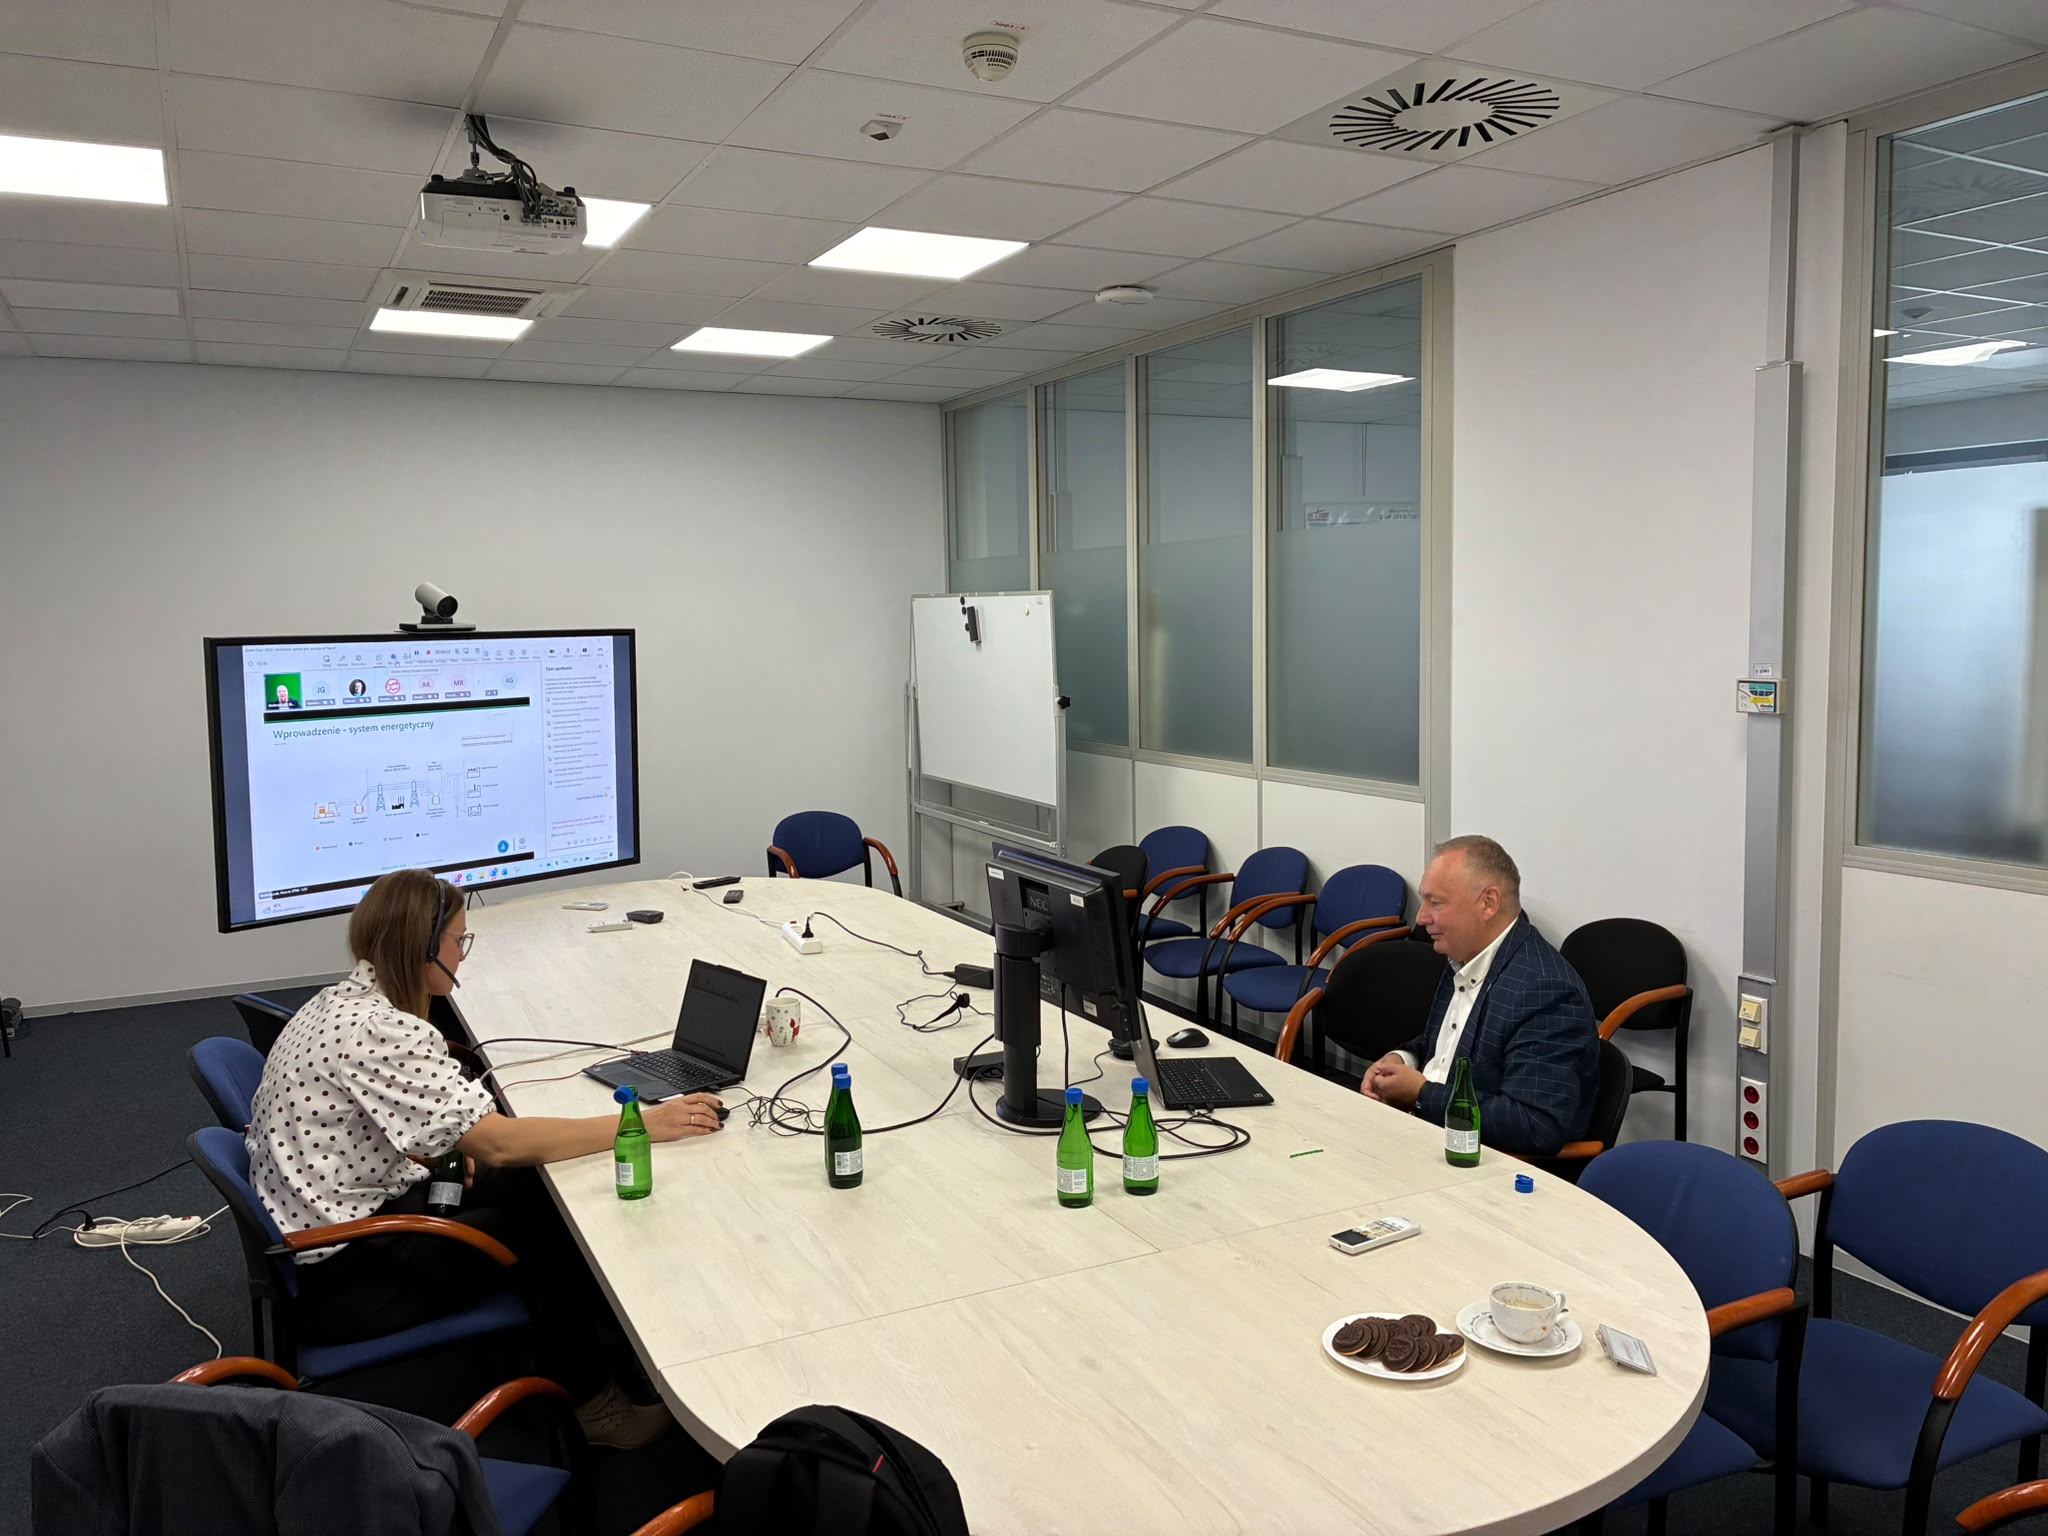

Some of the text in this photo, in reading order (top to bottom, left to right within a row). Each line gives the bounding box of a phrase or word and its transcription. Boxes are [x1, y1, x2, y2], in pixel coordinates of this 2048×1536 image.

[316, 686, 326, 694] JG
[272, 726, 341, 740] Wprowadzenie
[348, 725, 379, 735] system
[380, 720, 434, 731] energetyczny
[1029, 896, 1048, 911] NEC
